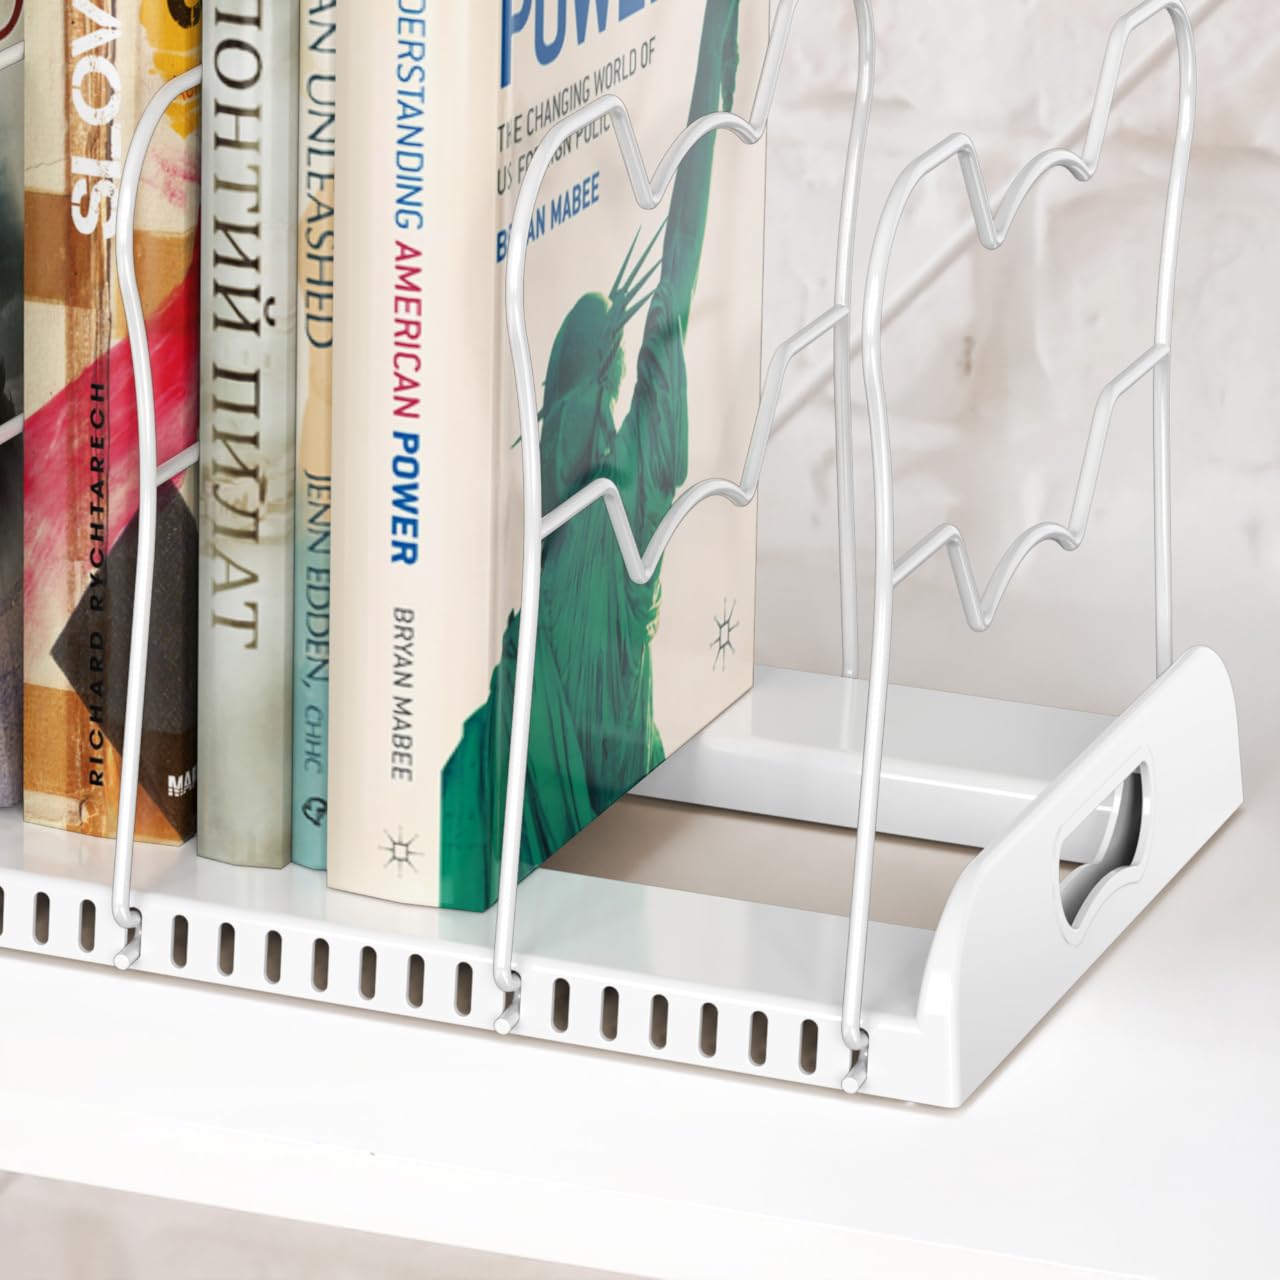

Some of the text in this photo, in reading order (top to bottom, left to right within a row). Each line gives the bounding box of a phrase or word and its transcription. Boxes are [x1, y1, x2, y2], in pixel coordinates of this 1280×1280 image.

[526, 76, 590, 136] CHANGING
[593, 48, 637, 96] WORLD
[640, 37, 656, 69] OF
[305, 74, 336, 349] UNLEASHED
[496, 171, 600, 264] BAN MABEE
[393, 240, 423, 419] AMERICAN
[211, 361, 261, 650] ПИЛАТ
[304, 469, 331, 555] JENN
[390, 431, 421, 567] POWER
[89, 632, 105, 786] RICHARD
[390, 607, 416, 782] BRYAN MABEE
